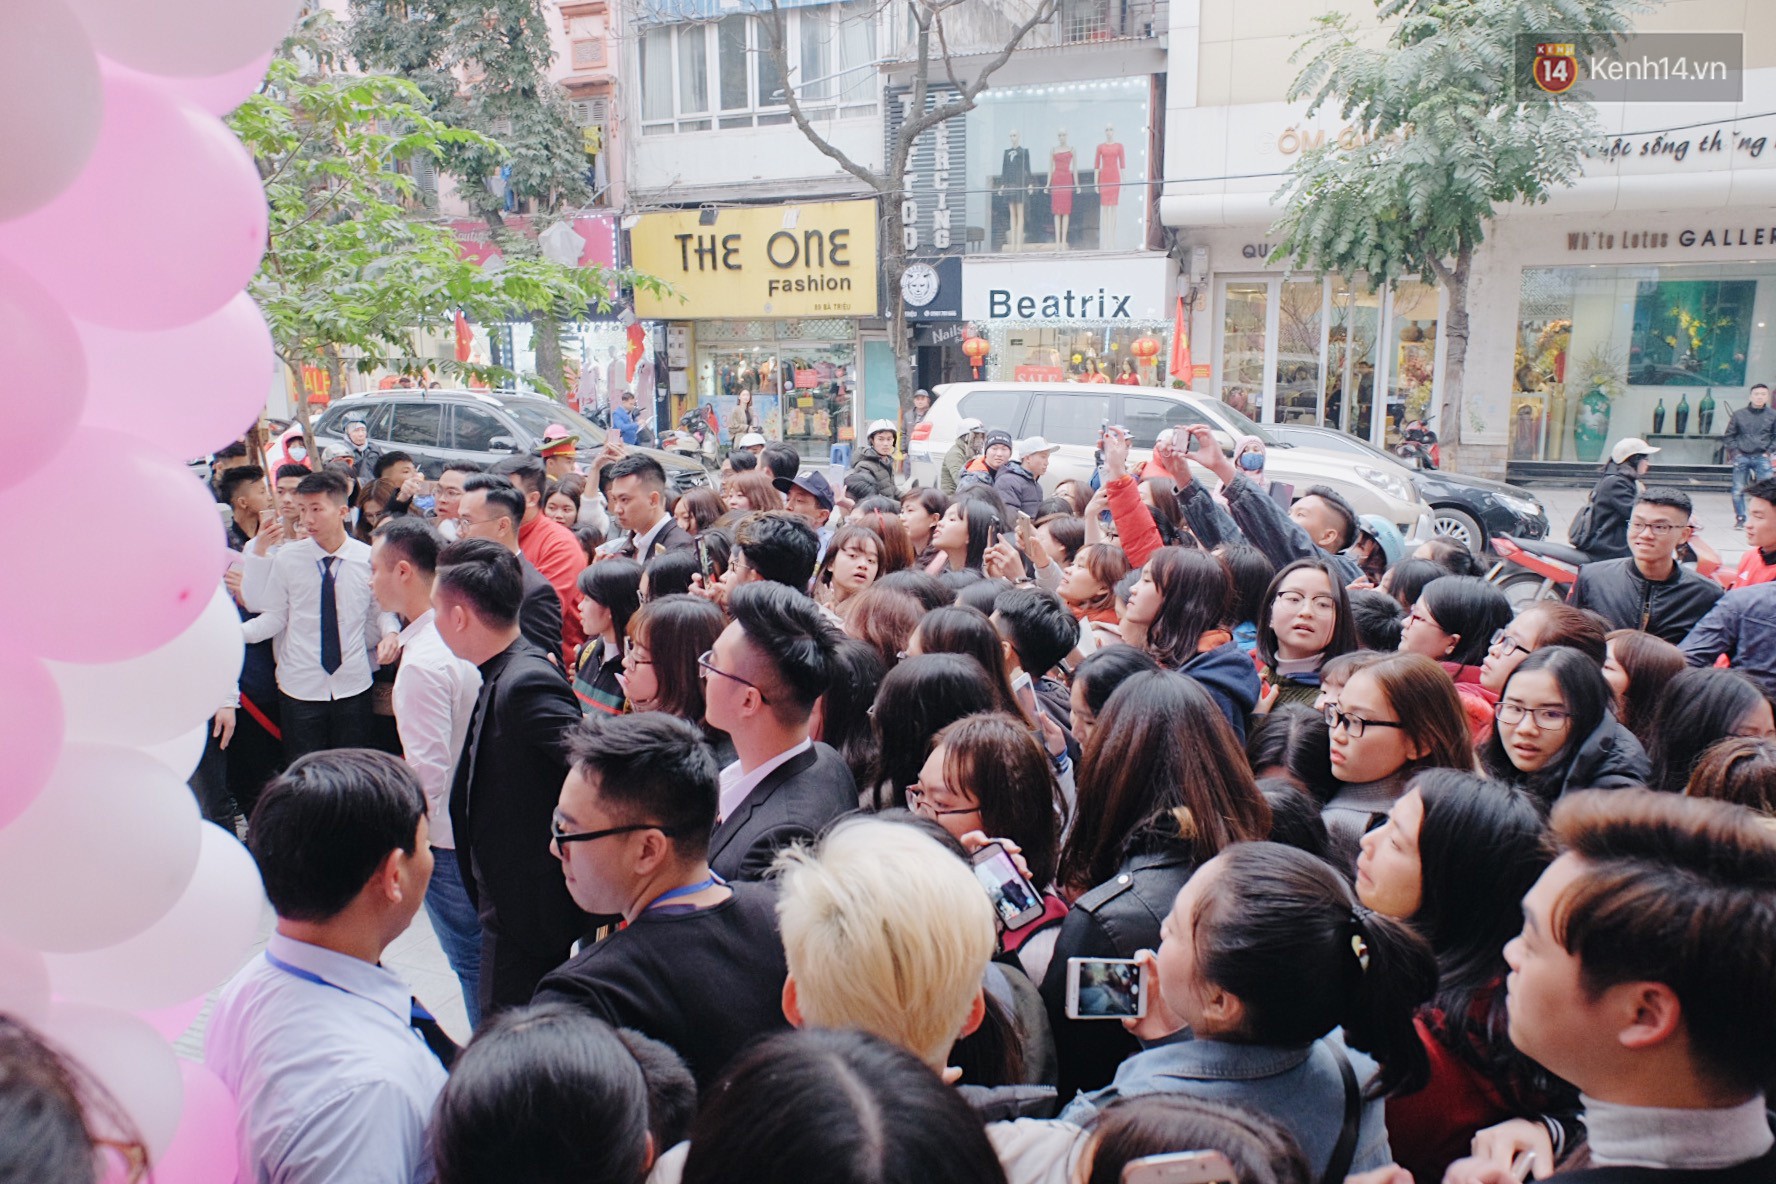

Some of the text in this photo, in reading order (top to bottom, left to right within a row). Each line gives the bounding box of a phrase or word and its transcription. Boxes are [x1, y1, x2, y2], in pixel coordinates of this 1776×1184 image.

[1640, 132, 1690, 162] sống
[1699, 129, 1768, 158] thng
[674, 233, 743, 272] THE
[1622, 230, 1669, 249] Lotus
[768, 275, 851, 297] Fashion
[989, 288, 1132, 319] Beatrix
[293, 370, 331, 395] ALE
